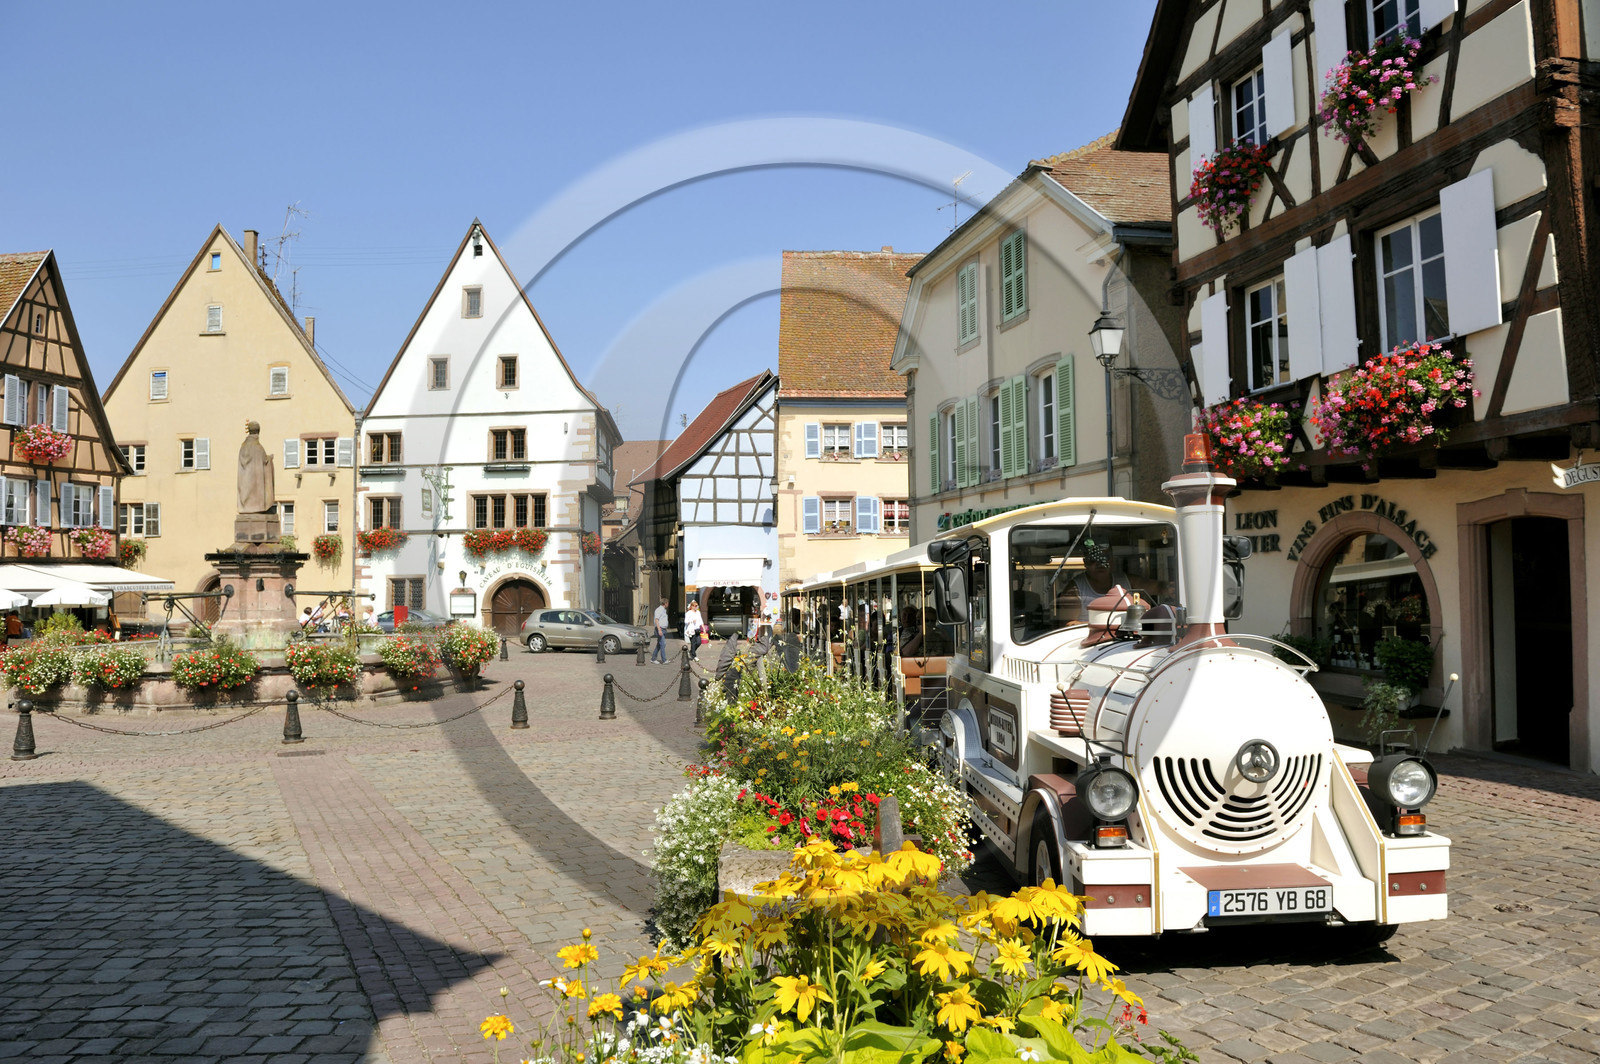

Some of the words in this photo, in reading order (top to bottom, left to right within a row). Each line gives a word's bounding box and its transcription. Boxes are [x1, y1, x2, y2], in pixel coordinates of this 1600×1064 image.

[1235, 509, 1278, 530] LEON
[1287, 520, 1317, 562] VINS
[1318, 495, 1355, 524] FINS
[1360, 494, 1438, 560] D'ALSACE
[479, 566, 501, 588] CAVEAU
[1224, 892, 1268, 912] 2576
[1276, 891, 1297, 911] YB
[1305, 889, 1326, 909] 68
